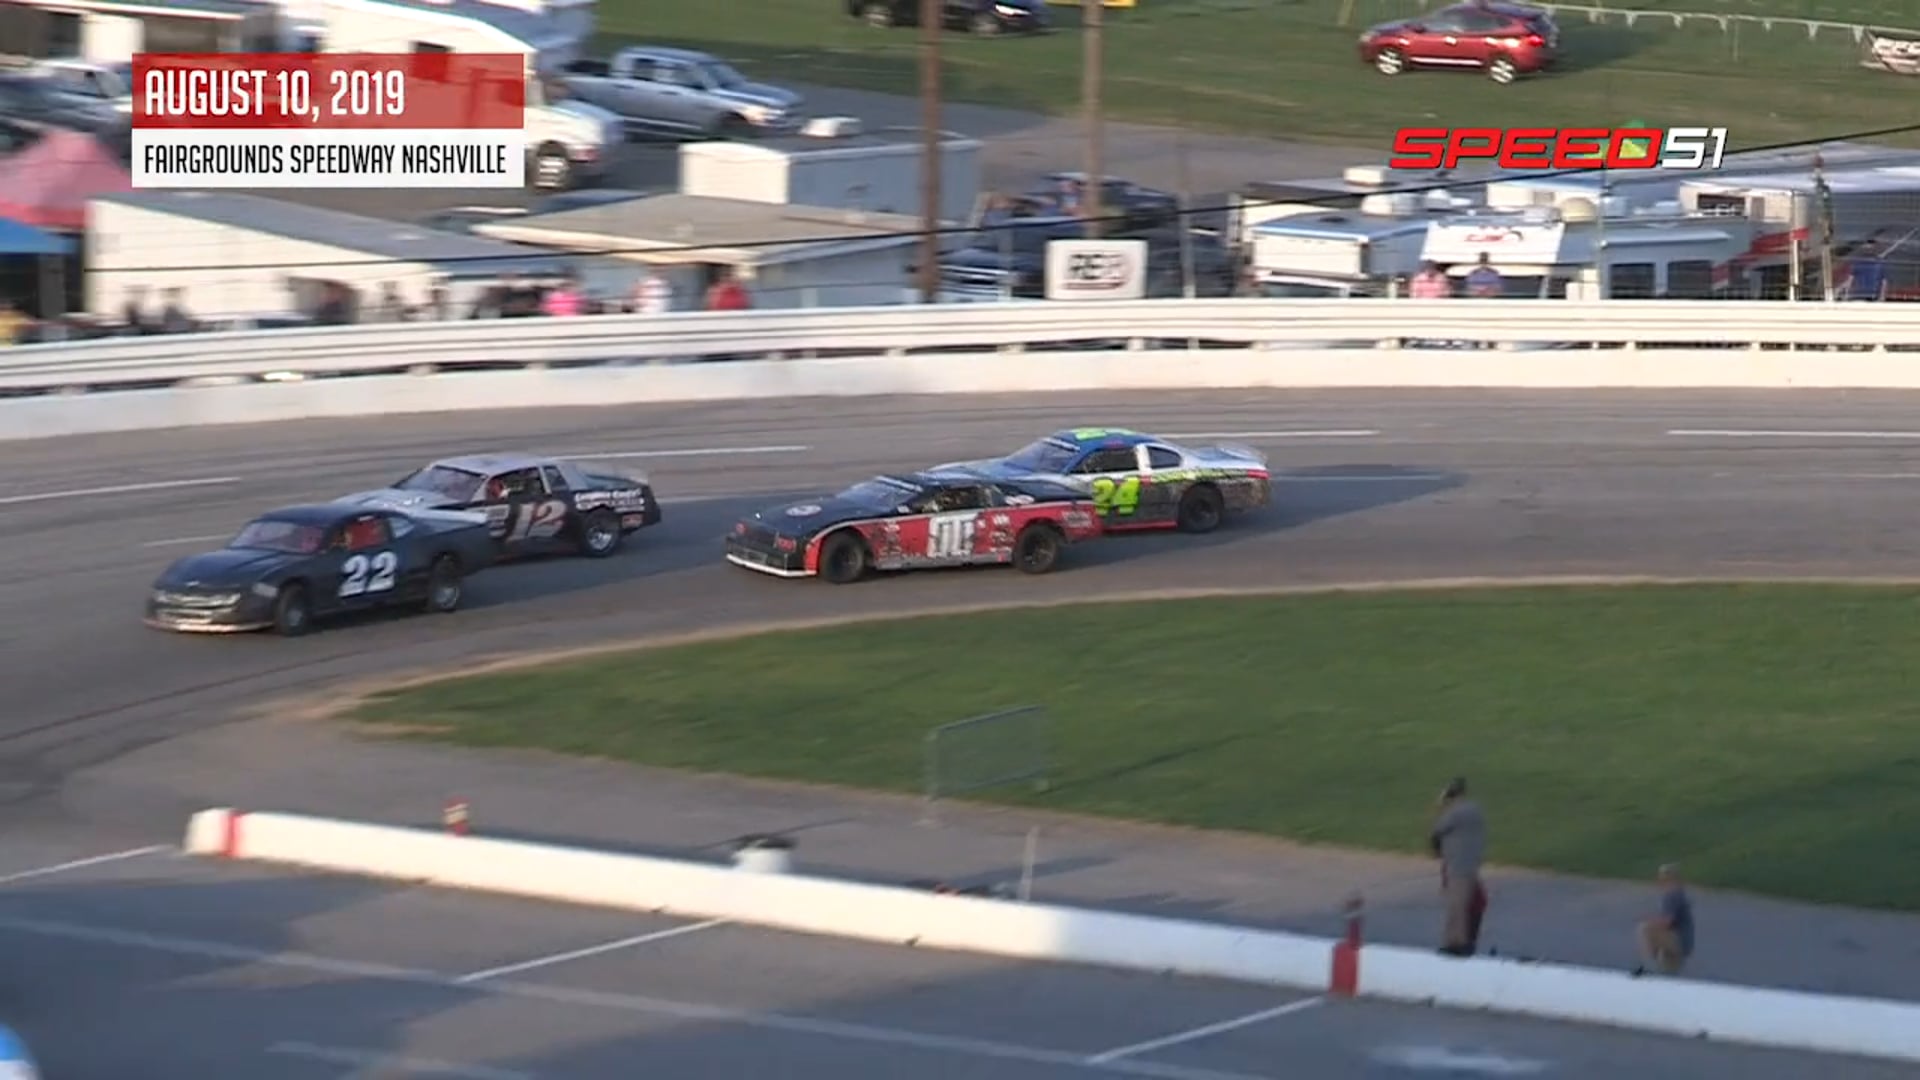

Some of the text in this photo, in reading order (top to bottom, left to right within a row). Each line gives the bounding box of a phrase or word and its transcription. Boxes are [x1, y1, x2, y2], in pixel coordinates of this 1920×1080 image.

[1092, 476, 1139, 516] 24
[507, 500, 567, 542] 12
[338, 551, 398, 597] 22
